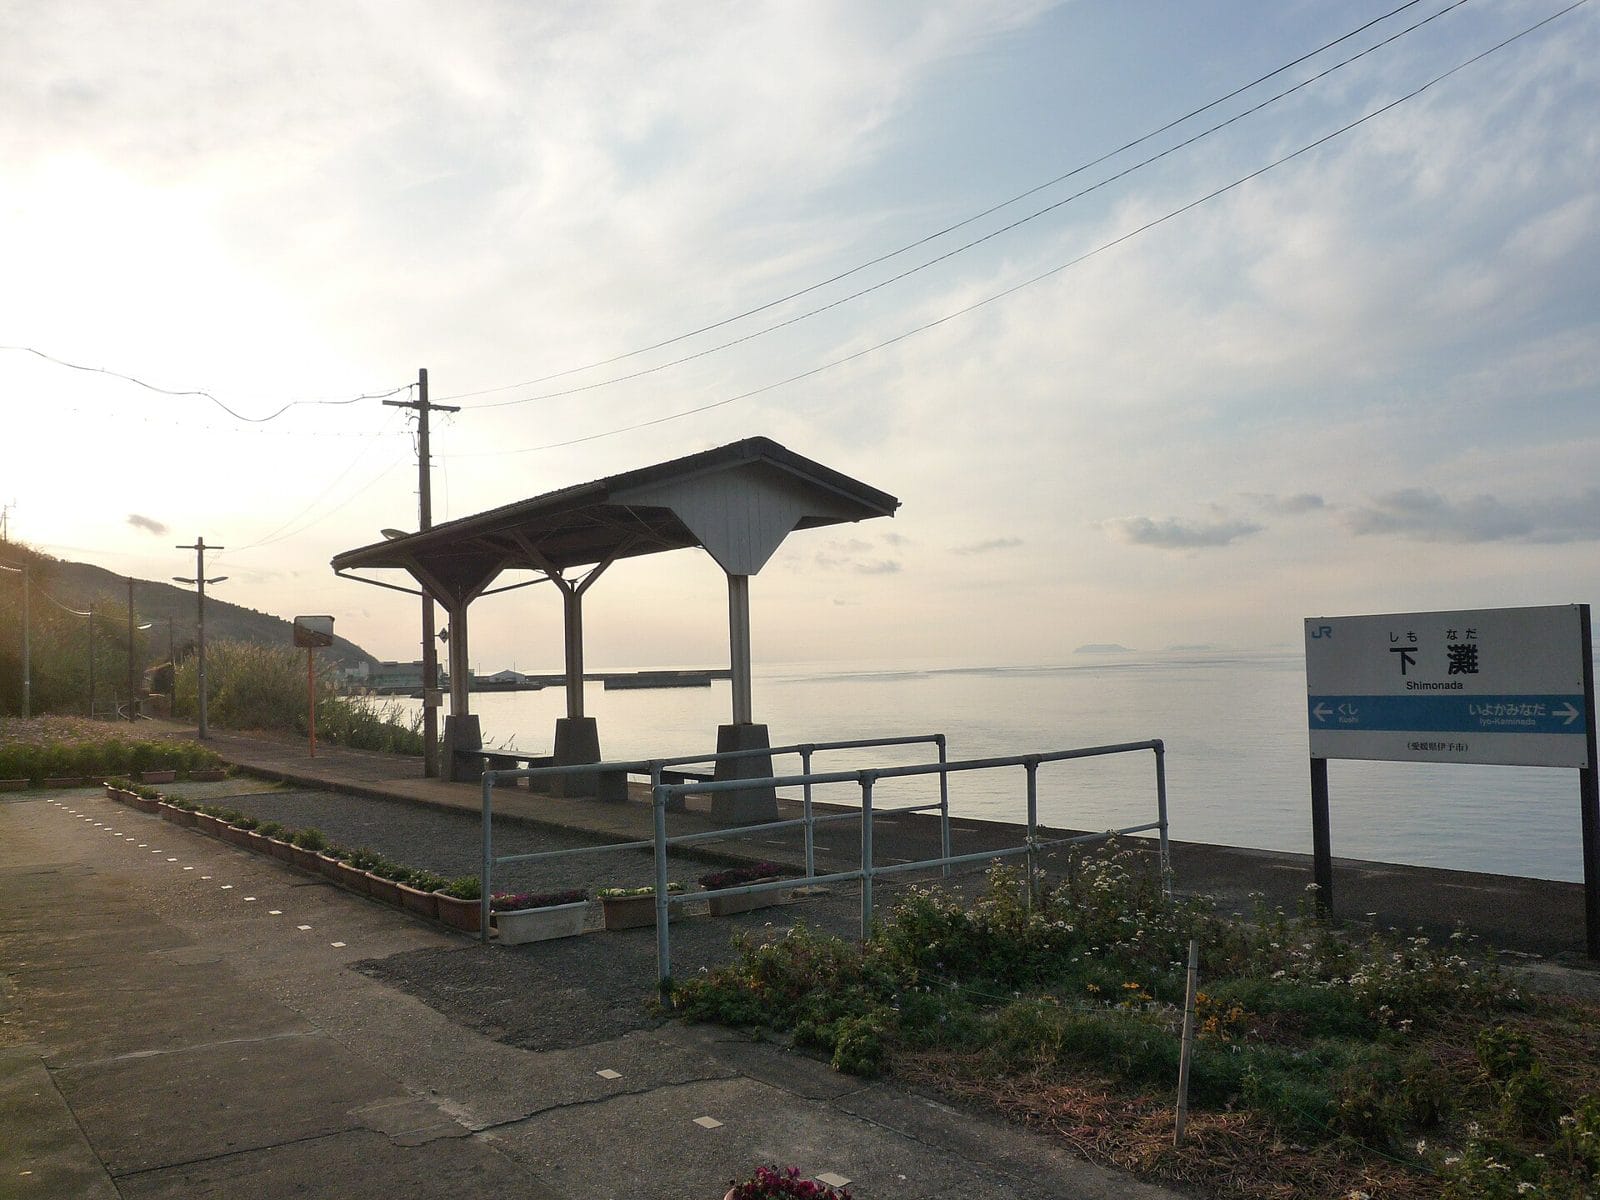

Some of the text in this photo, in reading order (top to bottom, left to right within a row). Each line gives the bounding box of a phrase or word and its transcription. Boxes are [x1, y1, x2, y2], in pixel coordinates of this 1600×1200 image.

[1311, 626, 1332, 639] JR
[1389, 643, 1480, 676] 下灘
[1406, 680, 1464, 691] Shimonada
[1337, 702, 1360, 716] くし
[1468, 702, 1547, 717] いよかみなだ
[1479, 717, 1537, 727] Iyo-Kaminada
